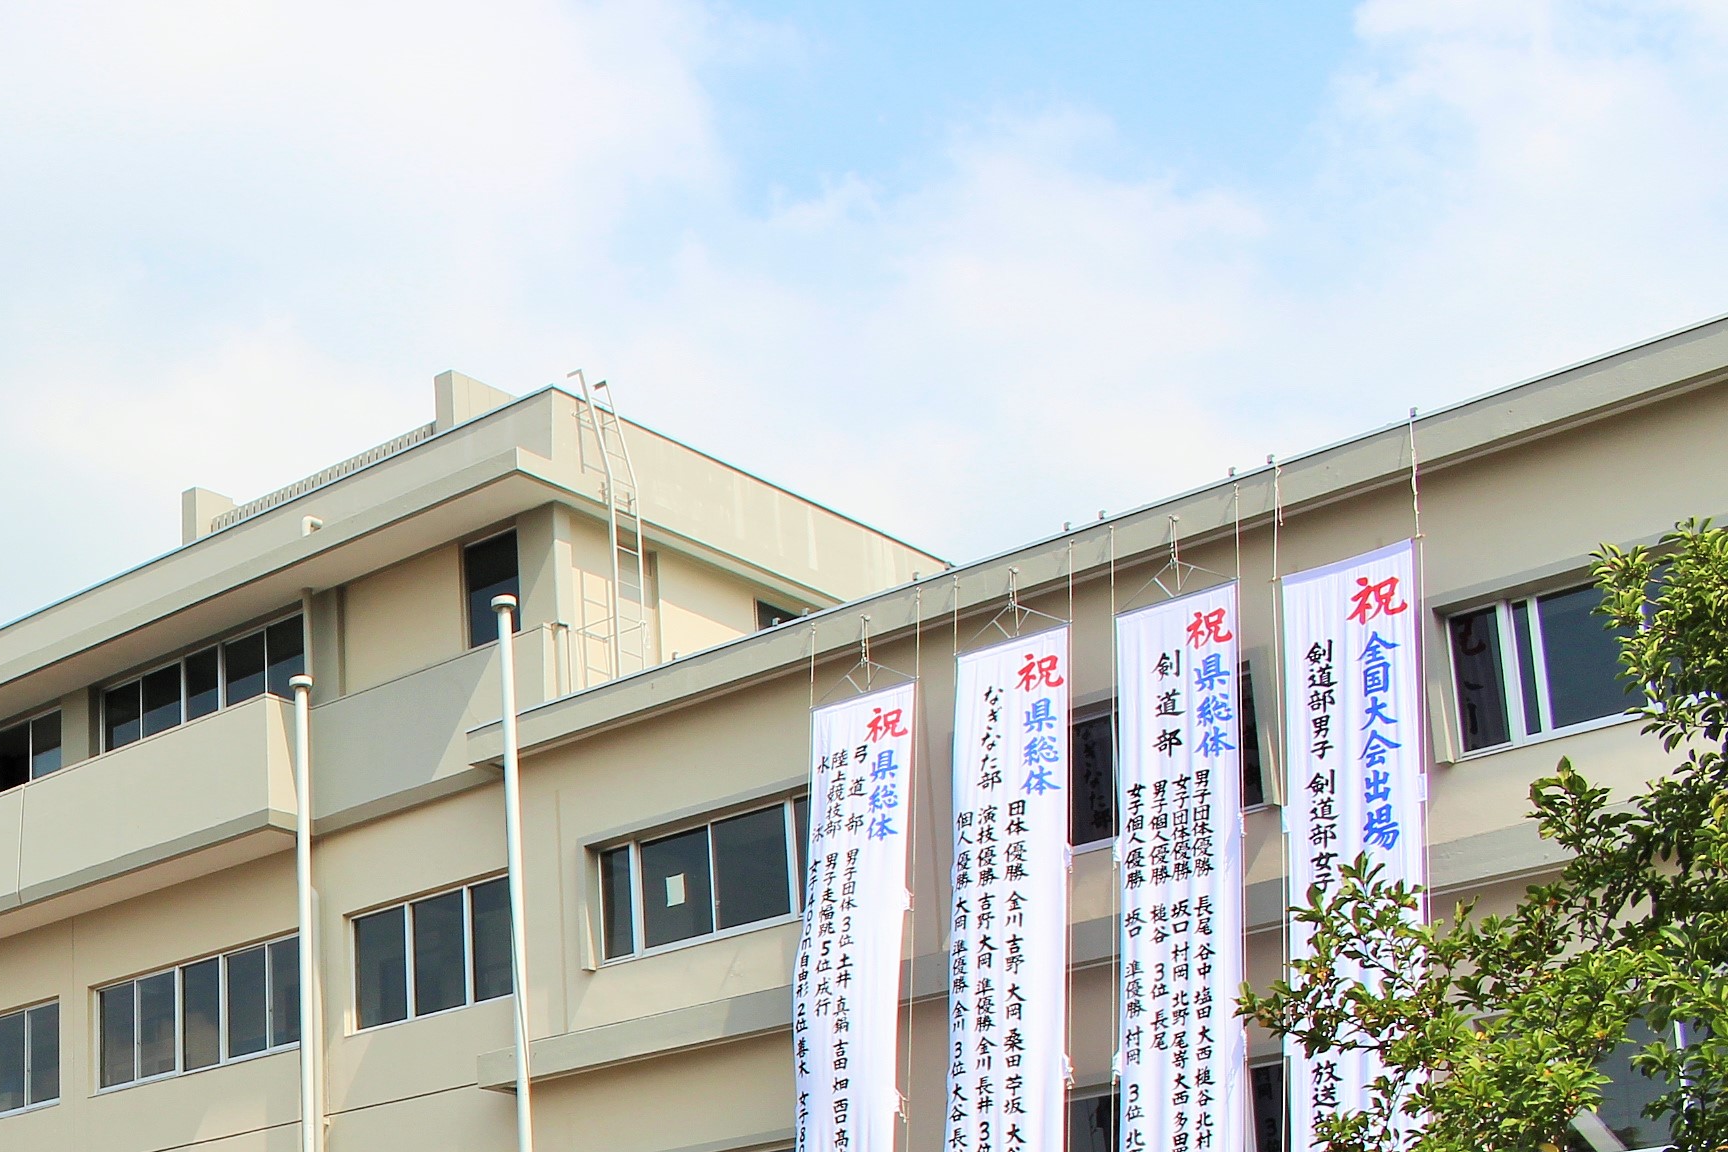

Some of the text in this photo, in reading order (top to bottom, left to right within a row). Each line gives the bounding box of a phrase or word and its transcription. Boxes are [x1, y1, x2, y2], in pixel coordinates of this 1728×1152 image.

[1186, 608, 1236, 758] 祝 県総体
[1304, 639, 1338, 760] 剣道部男子
[1152, 650, 1186, 758] 剣道部
[1346, 577, 1408, 850] 祝 全国大会出場
[977, 686, 1003, 791] なぎなた部
[1016, 654, 1064, 795] 祝 県総体
[844, 744, 868, 834] 弓道部
[864, 708, 908, 840] 祝 県総体
[1124, 783, 1146, 890] 女子個人優勝
[1149, 780, 1171, 887] 男子個人優勝
[1170, 774, 1192, 885] 女子団体優勝
[1191, 769, 1214, 877] 男子団体優勝
[1305, 768, 1340, 895] 剣道部女子
[815, 749, 848, 1017] 陸上競技部 男子走幅跳 5位 成行
[840, 848, 859, 911] 男子団体
[954, 897, 970, 932] 大岡
[977, 892, 996, 930] 吉野
[1006, 891, 1028, 927] 金川
[1124, 908, 1147, 938] 坂口
[1170, 898, 1192, 934] 坂口
[1194, 895, 1214, 935] 長尾
[839, 916, 854, 948] 3位
[977, 934, 998, 969] 大岡
[836, 953, 853, 988] 土井
[952, 940, 969, 994] 準優勝
[1005, 934, 1024, 974] 吉野
[1172, 941, 1190, 982] 村岡
[1194, 942, 1216, 980] 谷中
[1125, 960, 1147, 1019] 準優勝
[1150, 963, 1170, 1000] 3位
[796, 1003, 808, 1034] 2位
[952, 1000, 970, 1032] 金川
[974, 978, 996, 1032] 準優勝
[1006, 983, 1026, 1020] 大岡
[1172, 990, 1190, 1026] 北野
[1194, 991, 1212, 1020] 塩田
[1004, 1028, 1025, 1068] 桑田
[1126, 1026, 1144, 1065] 村岡
[1150, 1009, 1169, 1050] 長尾
[1196, 1026, 1214, 1061] 大西
[796, 1037, 810, 1078] 善木
[833, 1039, 848, 1070] 吉田
[951, 1042, 966, 1078] 3位
[976, 1036, 998, 1070] 金川
[833, 1077, 849, 1094] 畑
[949, 1083, 968, 1122] 大谷
[975, 1076, 994, 1114] 長井
[1125, 1084, 1144, 1122] 3位
[1172, 1073, 1191, 1106] 大西
[833, 1098, 848, 1124] 西口
[1195, 1112, 1214, 1150] 北村
